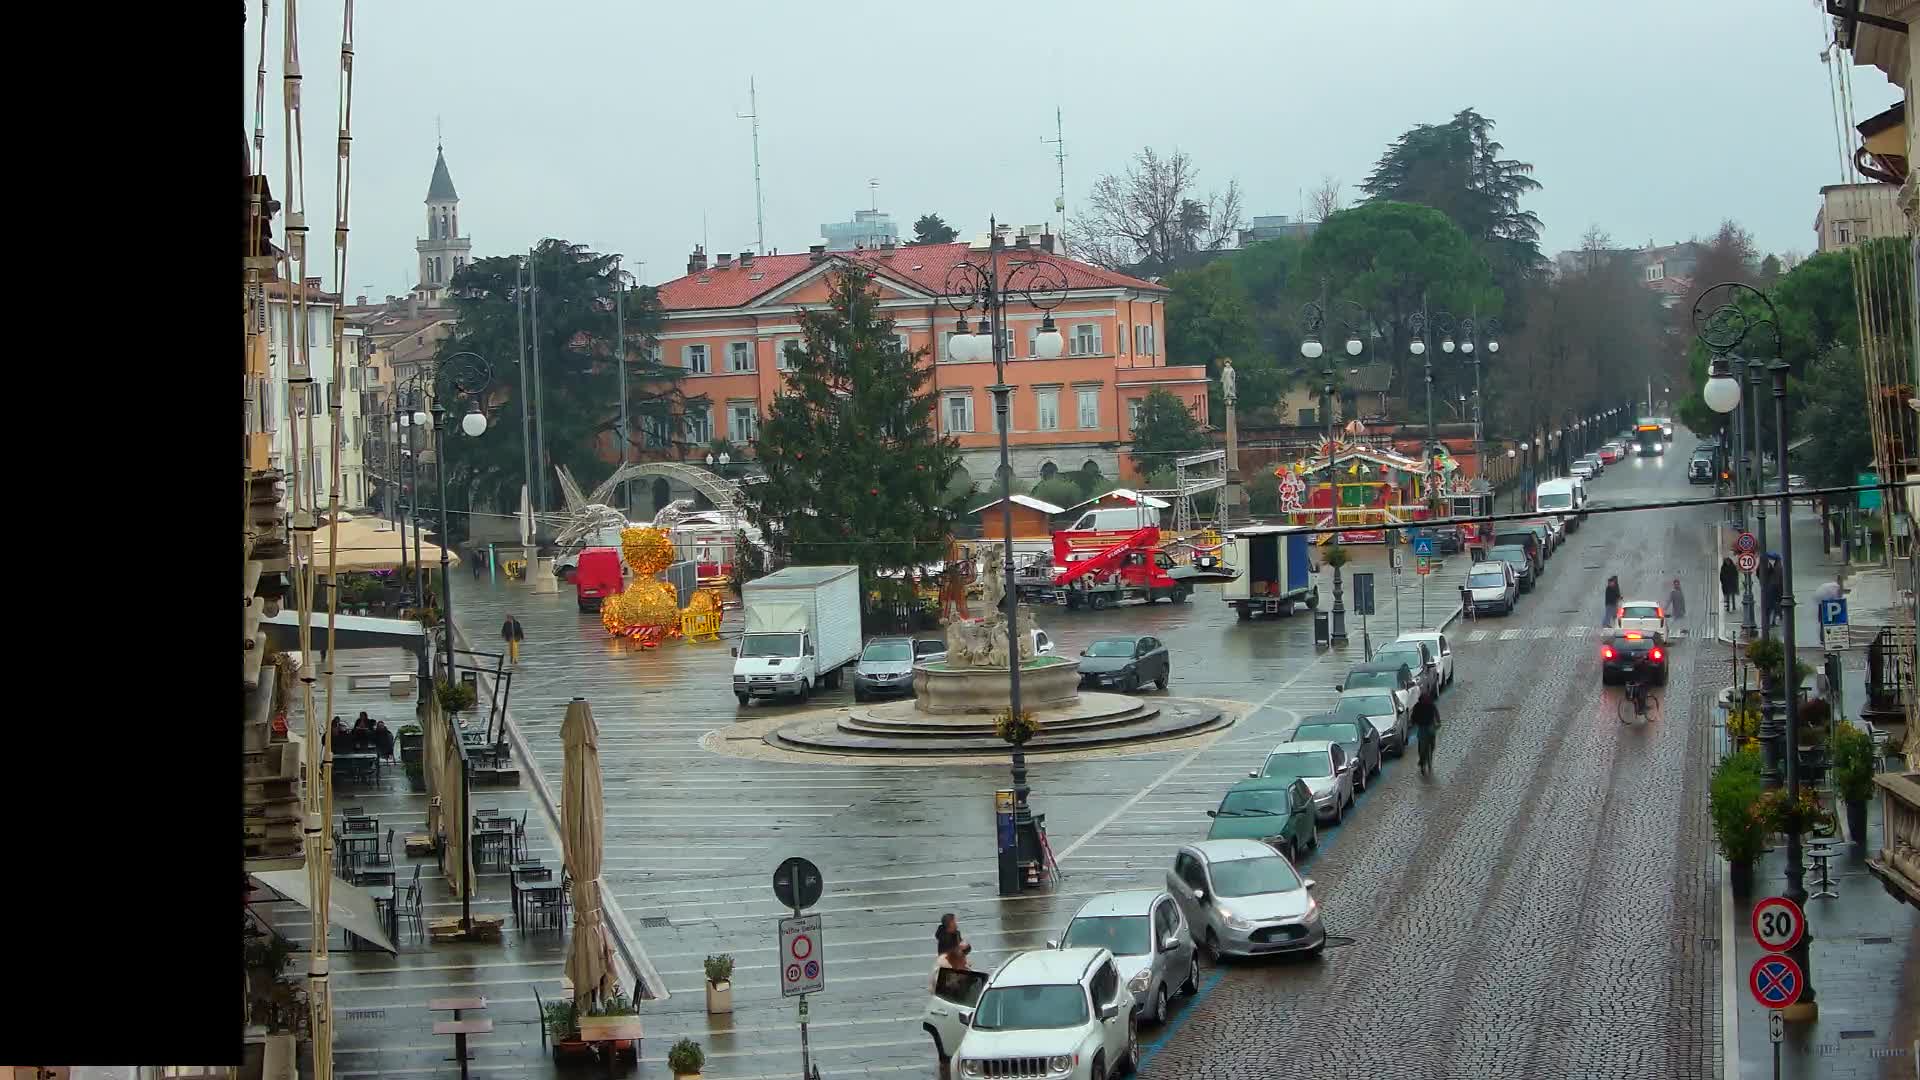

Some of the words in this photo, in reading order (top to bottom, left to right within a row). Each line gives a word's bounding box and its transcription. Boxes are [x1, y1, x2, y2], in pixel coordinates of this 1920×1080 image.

[1742, 557, 1753, 567] 20
[1827, 602, 1842, 622] P
[1762, 911, 1791, 937] 30
